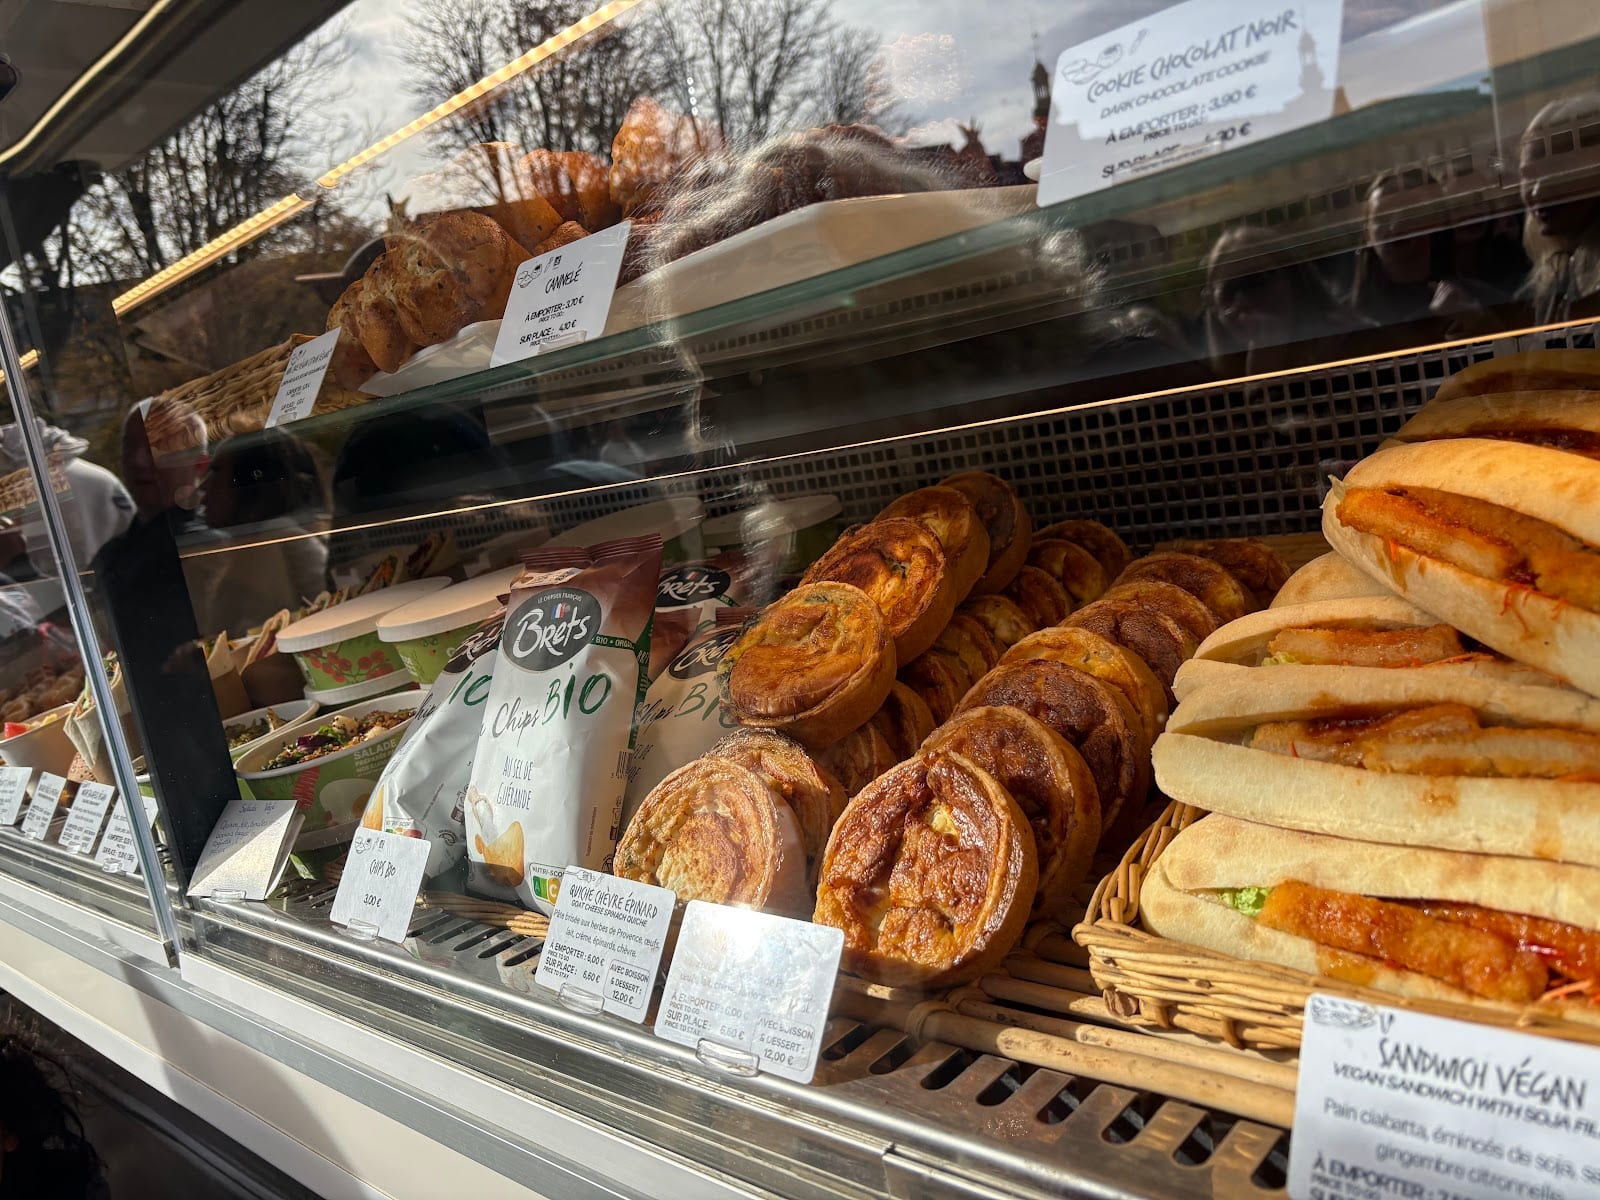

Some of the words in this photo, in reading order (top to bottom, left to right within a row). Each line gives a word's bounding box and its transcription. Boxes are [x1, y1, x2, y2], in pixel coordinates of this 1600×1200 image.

[1088, 64, 1147, 104] COOKIE
[1151, 24, 1246, 81] CHOCOLAT
[1245, 8, 1298, 48] NOIR
[1100, 98, 1134, 120] DARK
[1135, 70, 1216, 107] CHOCOLATE
[1215, 50, 1271, 78] COOKIE
[1119, 103, 1200, 141] EMPORTER
[1244, 84, 1258, 100] €
[1239, 121, 1252, 137] €
[545, 261, 583, 294] CANNELÉ
[531, 303, 563, 320] EMPORTER
[519, 333, 533, 345] SUR
[532, 327, 552, 341] PLACE
[492, 697, 540, 748] Chips
[353, 739, 398, 762] SALADE
[502, 755, 513, 778] AU
[512, 758, 524, 780] SEL
[523, 761, 534, 781] DE
[497, 782, 532, 810] GUÉRANDE
[369, 859, 386, 878] CHIPS
[384, 861, 397, 879] BIO
[376, 897, 382, 908] €
[569, 883, 594, 903] QUICHE
[595, 886, 624, 911] CHÈVRE
[624, 891, 659, 920] ÉPINARD
[584, 903, 605, 916] CHEESE
[604, 909, 632, 923] SPINACH
[631, 914, 654, 929] QUICHE
[584, 917, 595, 928] aux
[595, 919, 609, 934] herbes
[608, 926, 618, 936] de
[616, 927, 643, 945] Provence,
[555, 942, 585, 961] EMPORTER
[600, 958, 606, 968] €
[545, 956, 558, 968] SUR
[556, 961, 575, 975] PLACE
[595, 975, 601, 984] €
[610, 962, 626, 976] AVEC
[624, 967, 650, 984] BOISSON
[612, 989, 629, 1004] 12,00
[628, 994, 635, 1006] €
[615, 977, 639, 994] DESSERT
[666, 1009, 683, 1022] SUR
[682, 1013, 708, 1030] PLACE
[738, 1031, 745, 1042] €
[758, 1015, 778, 1030] AVEC
[763, 1048, 787, 1065] 12,00
[786, 1055, 795, 1067] €
[766, 1034, 800, 1054] DESSERT
[1379, 1037, 1489, 1091] SANDWICH
[1495, 1056, 1588, 1111] VÉGAN
[1333, 1061, 1385, 1088] VEGAN
[1386, 1075, 1475, 1108] SANDWICH
[1476, 1095, 1522, 1120] WITH
[1523, 1105, 1571, 1131] SOJA
[1323, 1097, 1359, 1122] Pain
[1359, 1109, 1429, 1142] ciabatta,
[1431, 1124, 1504, 1160] émincés
[1506, 1146, 1532, 1166] de
[1312, 1150, 1326, 1172] À
[1328, 1158, 1425, 1200] EMPORTER
[1375, 1143, 1466, 1182] gingembre
